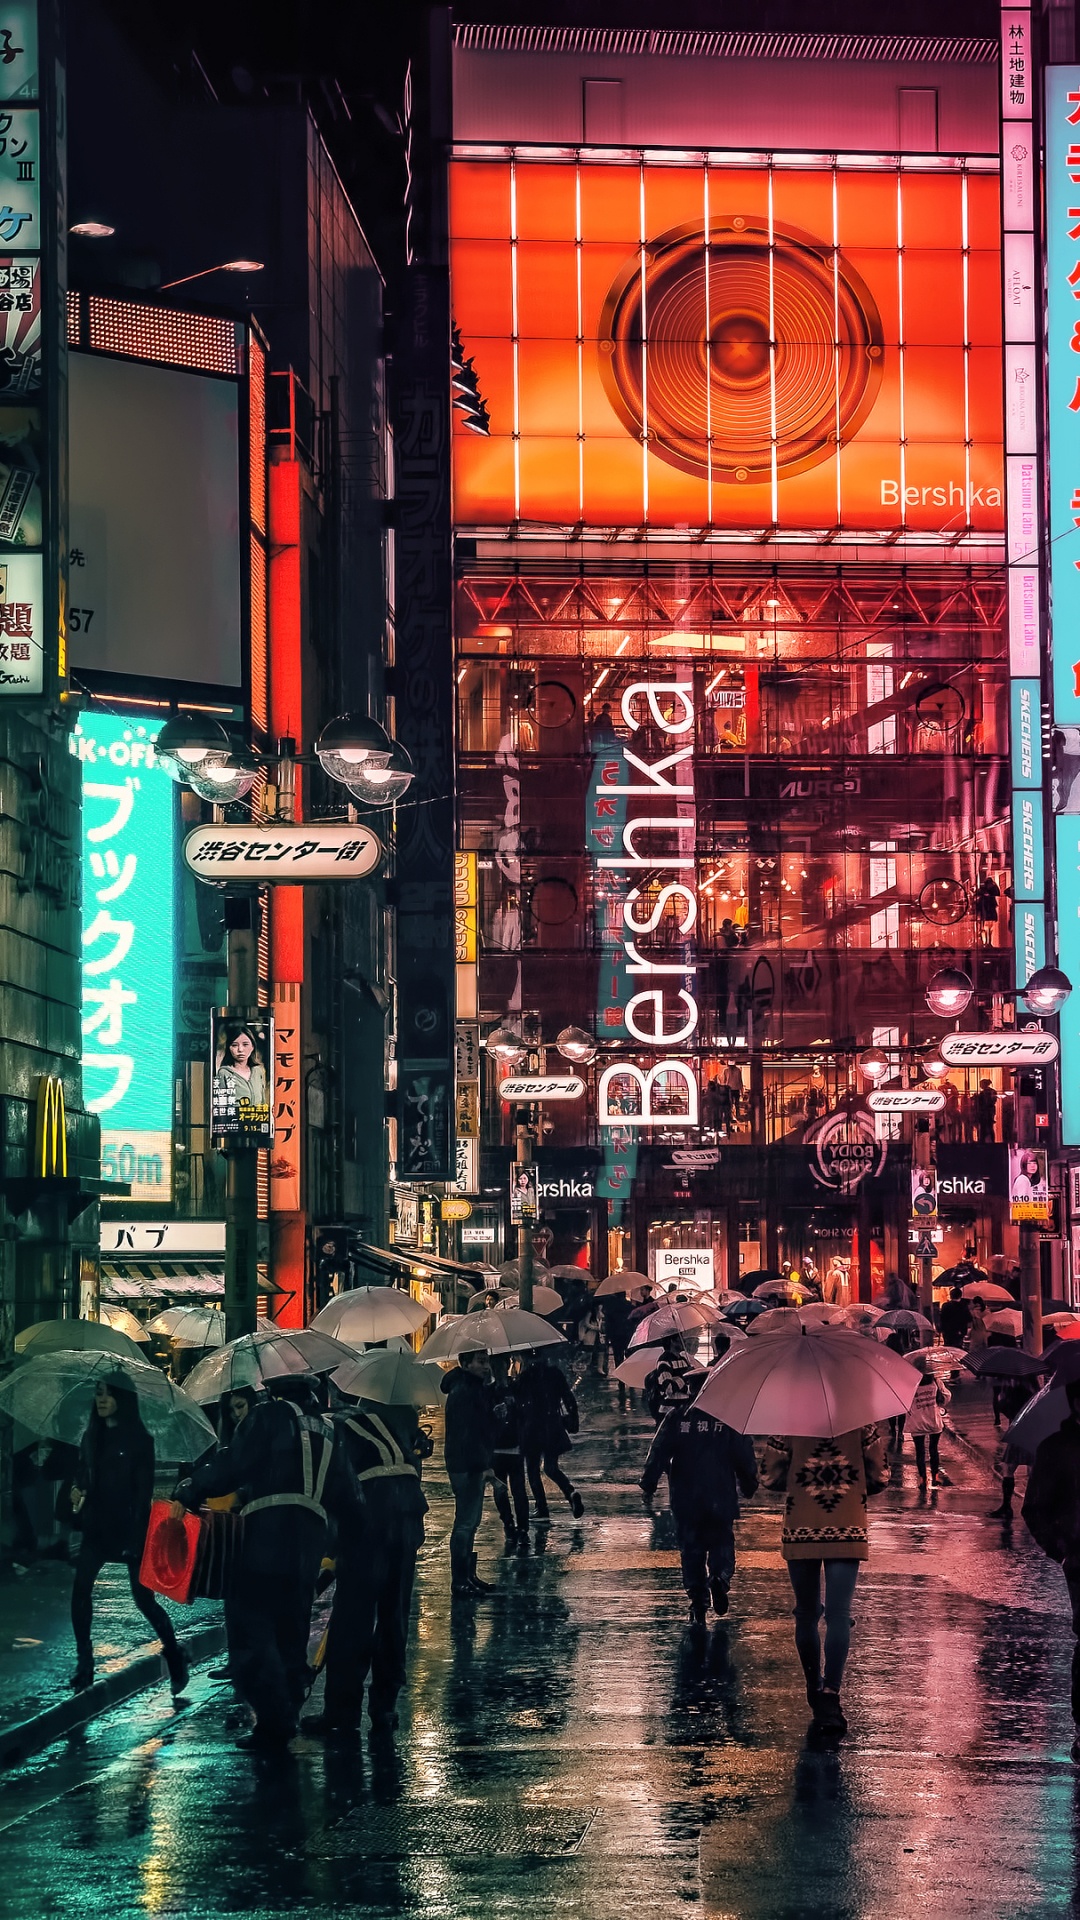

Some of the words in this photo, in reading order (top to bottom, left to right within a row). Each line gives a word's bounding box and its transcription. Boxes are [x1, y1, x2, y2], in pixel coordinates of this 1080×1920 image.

[1009, 25, 1025, 105] 林土地建物
[19, 85, 39, 98] 4F
[1013, 270, 1021, 307] AFLOAT
[880, 480, 1001, 507] Bershka
[1022, 464, 1033, 508] Datsumo
[1022, 513, 1034, 535] Labo
[69, 549, 85, 567] 先
[1024, 575, 1035, 620] Datsumo
[69, 607, 94, 633] 57
[1024, 623, 1036, 647] Labo
[1020, 688, 1032, 779] SKECHERS
[192, 840, 368, 861] 渋谷センター街
[1022, 800, 1034, 891] SKECHERS
[596, 682, 698, 1126] Bershka
[80, 776, 141, 1114] ブックオフ
[946, 1041, 1053, 1055] 渋谷センター街
[275, 1028, 296, 1143] マモケバブ
[503, 1082, 580, 1094] 渋谷センター街
[872, 1096, 941, 1106] 渋谷センター街
[101, 1143, 164, 1185] 50m
[664, 1254, 710, 1265] Bershka
[680, 1420, 724, 1433] 警視庁
